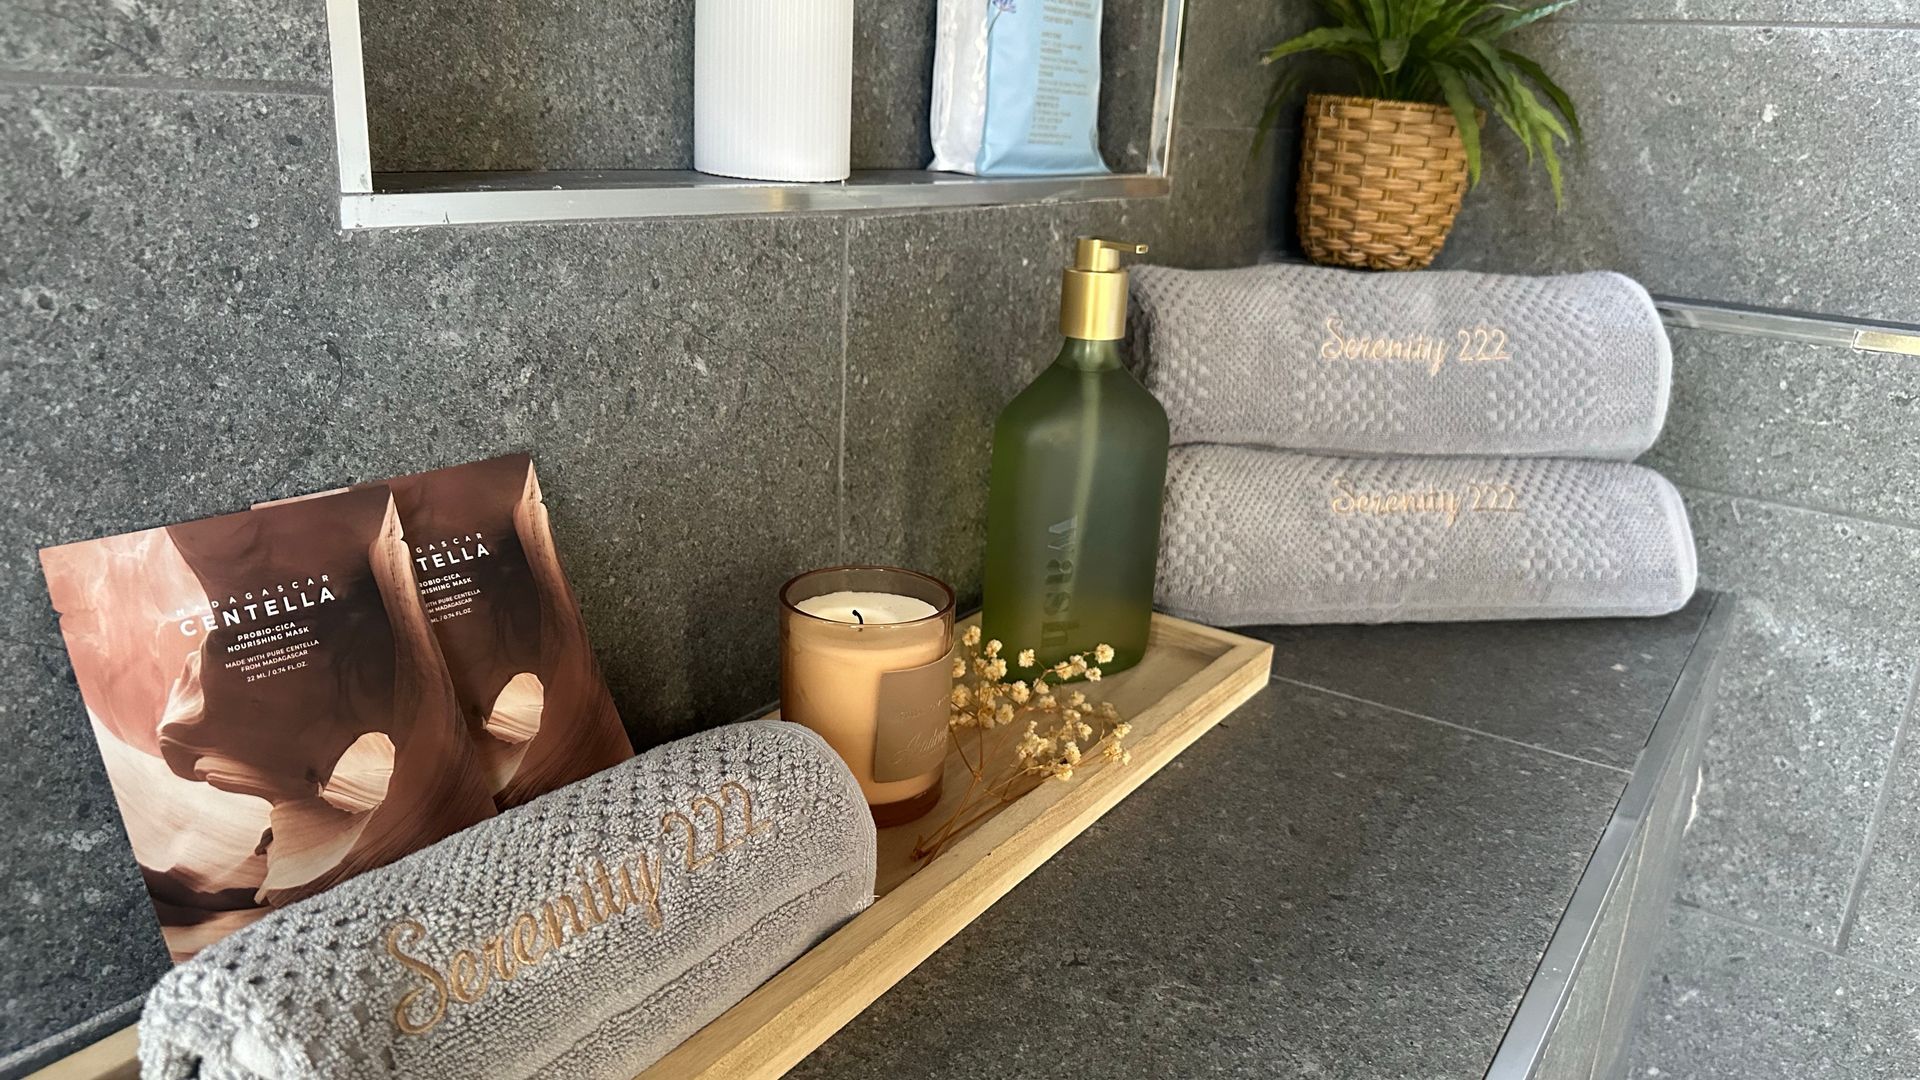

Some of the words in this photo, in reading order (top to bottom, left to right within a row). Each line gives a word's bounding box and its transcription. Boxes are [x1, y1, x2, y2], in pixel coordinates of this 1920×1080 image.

[1321, 315, 1449, 376] Serenity
[1458, 326, 1512, 361] 222
[1331, 475, 1462, 527] Serenity
[1466, 481, 1524, 512] 222
[416, 543, 490, 572] TELLA
[176, 574, 329, 617] MADAGASCAR
[452, 577, 472, 587] MASK
[435, 597, 473, 612] MADAGASCAR
[438, 596, 453, 604] PURE
[453, 589, 481, 600] CENTELLA
[180, 586, 336, 637] CENTELLA
[227, 633, 283, 653] NOURISHING
[285, 626, 310, 638] MASK
[237, 621, 296, 641] PROBIO-CICA
[225, 658, 246, 669] MADE
[246, 653, 265, 663] WITH
[266, 648, 285, 658] PURE
[285, 639, 320, 653] CENTELLA
[241, 662, 261, 672] FROM
[262, 649, 308, 666] MADAGASCAR
[246, 675, 255, 683] 22
[256, 672, 267, 680] ML
[272, 667, 286, 676] 0.74
[387, 851, 662, 1035] Serenity
[661, 780, 773, 873] 222
